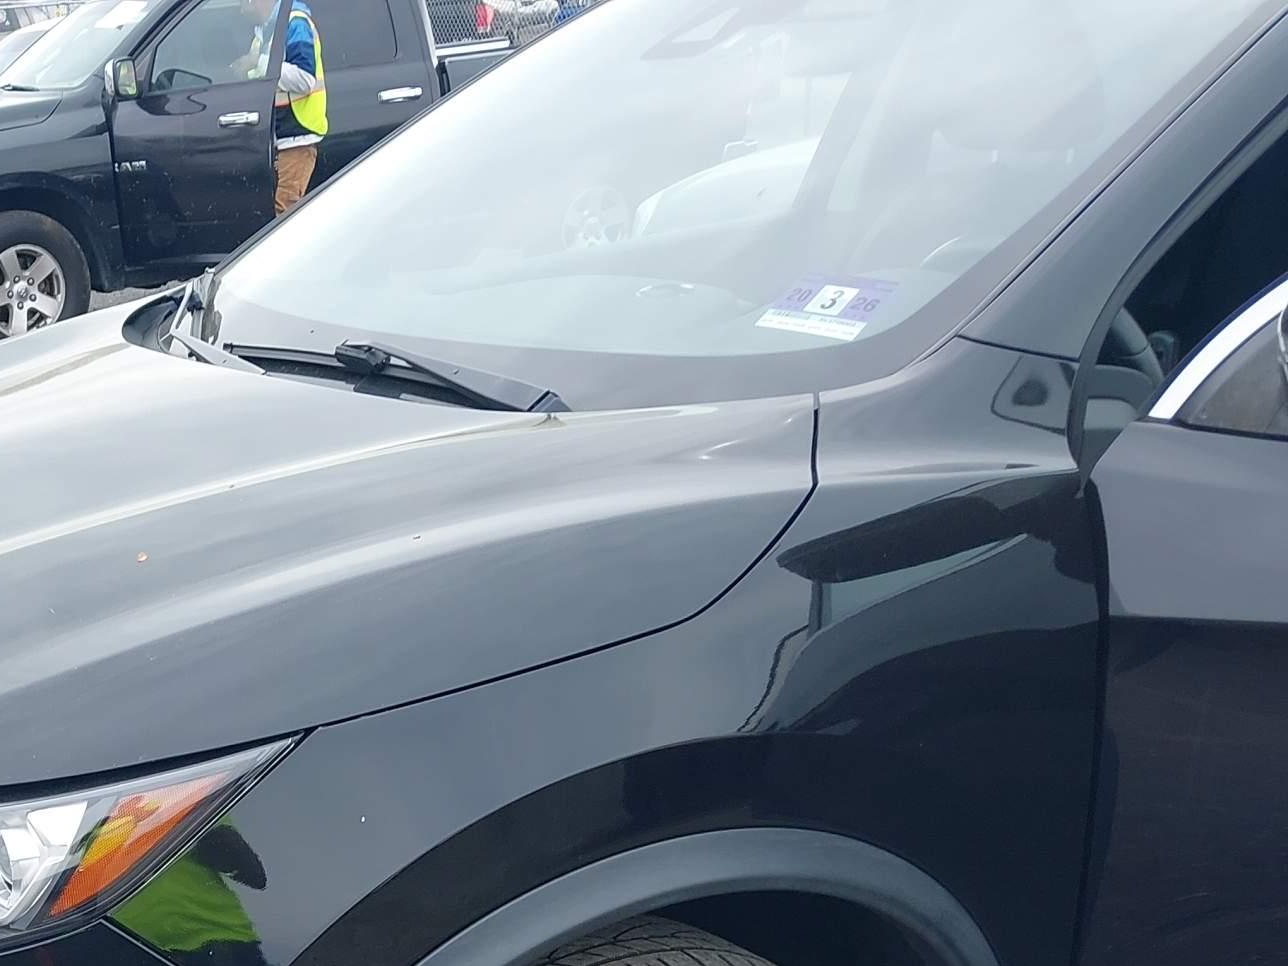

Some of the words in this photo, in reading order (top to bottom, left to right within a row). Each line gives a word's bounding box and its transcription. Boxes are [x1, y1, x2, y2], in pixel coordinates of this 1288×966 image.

[785, 287, 814, 304] 20
[819, 289, 845, 310] 3
[848, 296, 881, 314] 26
